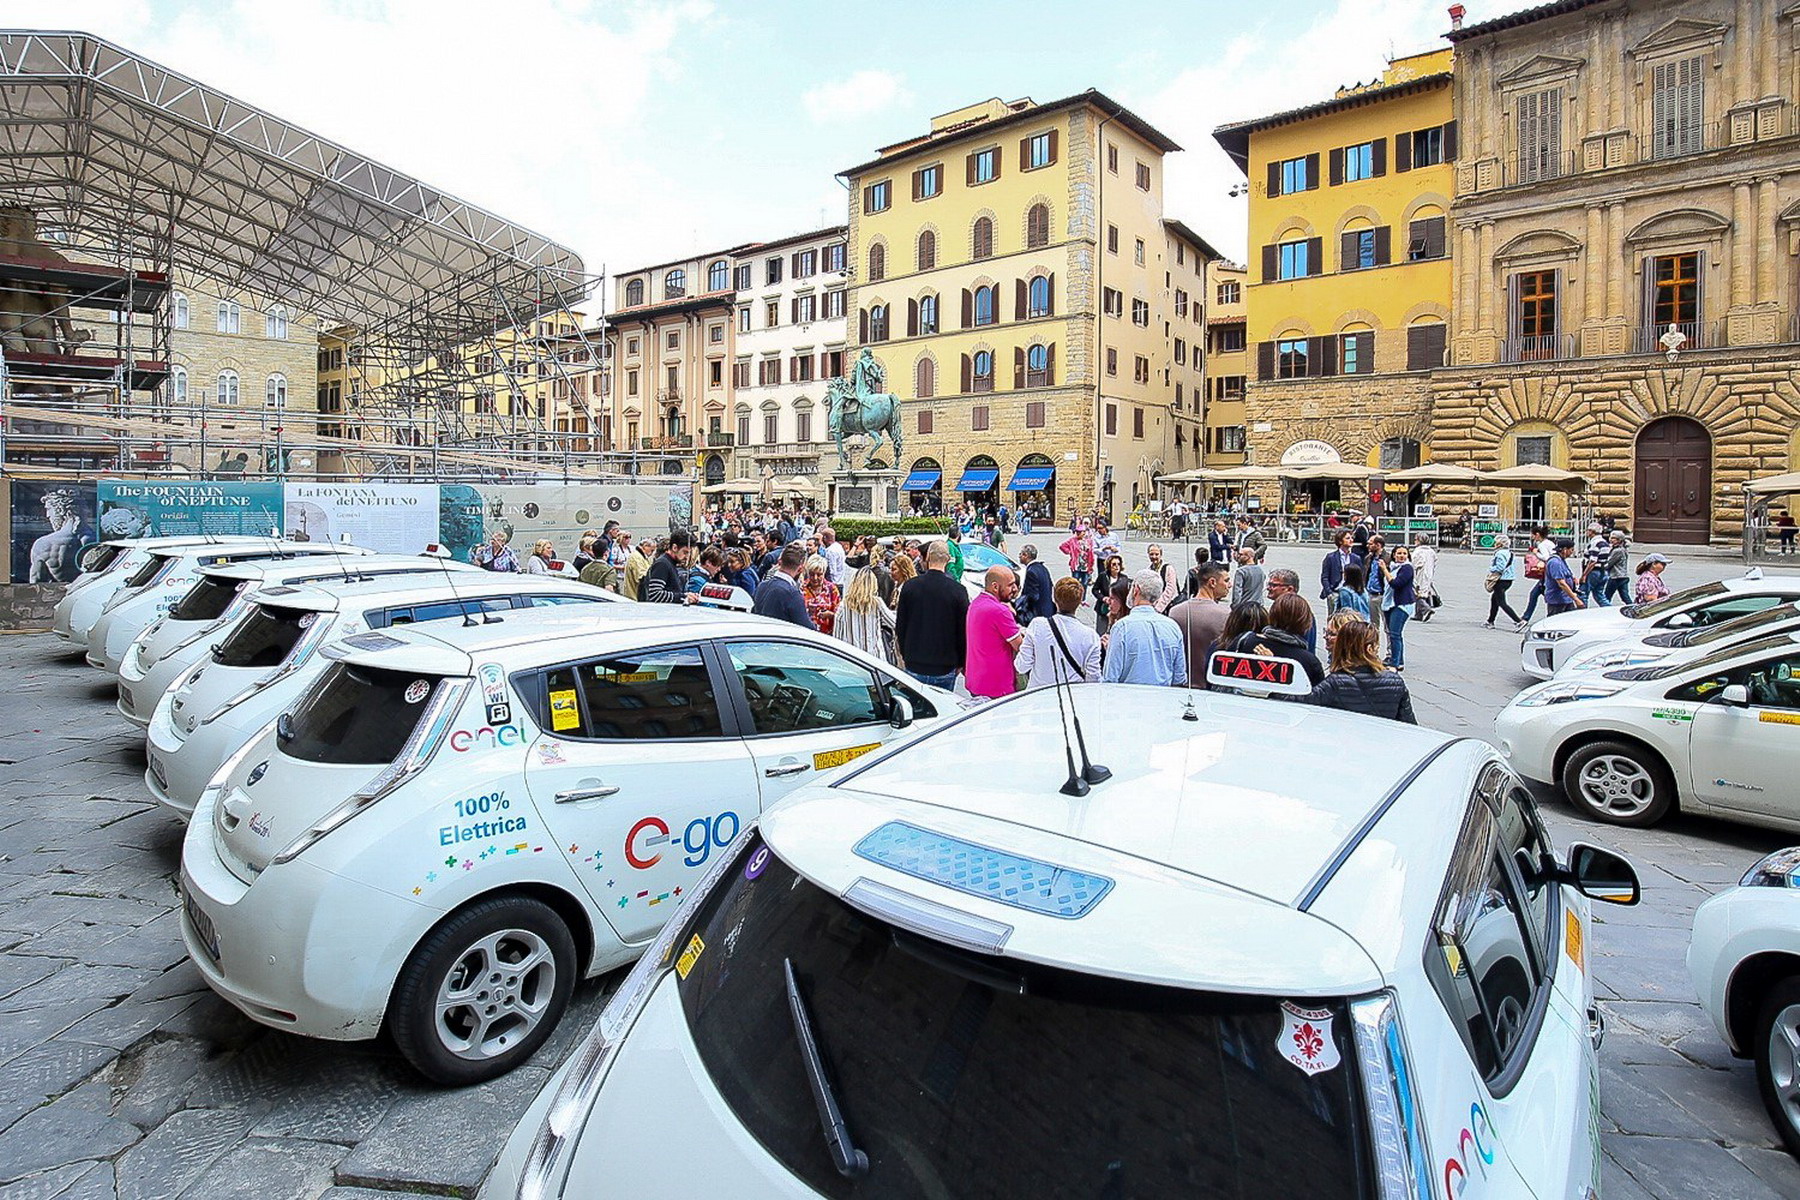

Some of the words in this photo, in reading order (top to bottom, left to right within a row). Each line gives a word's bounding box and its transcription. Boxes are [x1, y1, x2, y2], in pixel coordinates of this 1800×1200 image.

[1288, 443, 1332, 456] RISTORANTE
[112, 485, 142, 497] The
[144, 486, 224, 497] FOUNTAIN
[298, 488, 315, 497] La
[316, 488, 377, 498] FONTANA
[160, 496, 177, 506] of
[178, 497, 251, 506] NEPTUNE
[336, 497, 354, 506] del
[357, 497, 418, 506] NETTUNO
[160, 512, 190, 521] Origin
[703, 588, 731, 599] TAXI
[1216, 656, 1289, 683] TAXI
[488, 692, 504, 703] Wi
[493, 706, 506, 718] Fi
[450, 717, 527, 752] enel
[454, 791, 511, 818] 100%
[439, 814, 528, 846] Elettrica
